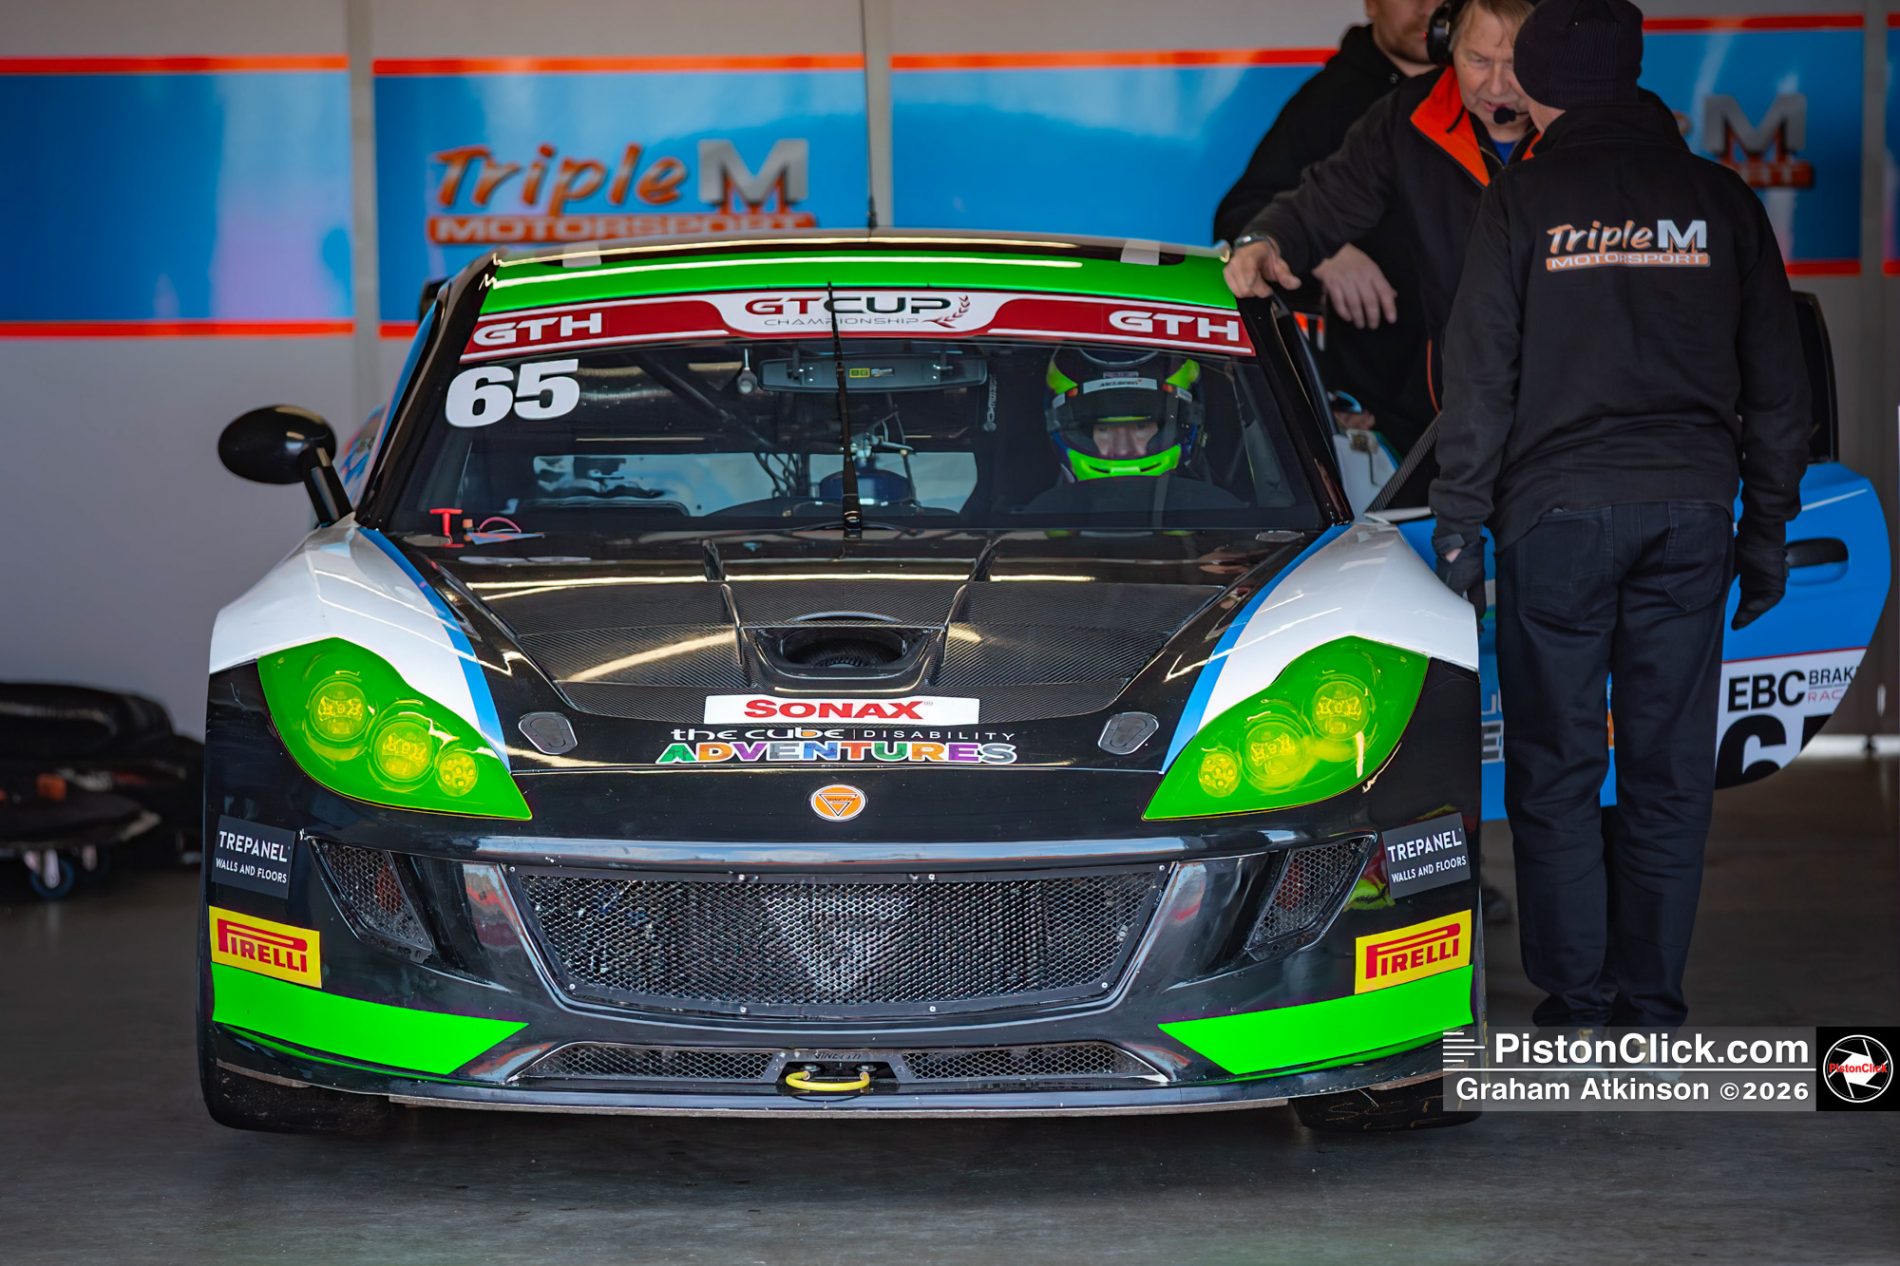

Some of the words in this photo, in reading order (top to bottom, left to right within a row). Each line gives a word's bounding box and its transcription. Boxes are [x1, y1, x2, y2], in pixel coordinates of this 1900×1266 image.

[434, 143, 688, 217] Triple
[435, 215, 808, 242] MOTORSPORT
[1546, 220, 1653, 254] Triple
[1657, 219, 1707, 250] M
[1550, 252, 1702, 269] MOTORSPORT
[473, 312, 602, 346] GTH
[763, 317, 919, 327] CHAMPIONSHIP
[1109, 309, 1239, 341] GTH
[445, 358, 581, 428] 65
[1728, 669, 1806, 713] EBC
[1808, 666, 1856, 685] BRAK
[744, 699, 924, 720] SONAX
[671, 728, 738, 741] the
[745, 726, 846, 741] cube
[864, 730, 1015, 740] DISABILITY
[655, 741, 1018, 764] ADVENTURES
[219, 831, 288, 863] TREPANEL
[1387, 829, 1462, 862] TREPANEL
[215, 857, 238, 873] WALLS
[239, 864, 256, 876] AND
[257, 867, 288, 884] FLOORS
[1391, 869, 1416, 883] WALLS
[1418, 863, 1434, 877] AND
[1436, 855, 1467, 872] FLOORS
[217, 918, 308, 973] PIRELLI
[1366, 922, 1461, 979] PIRELLI
